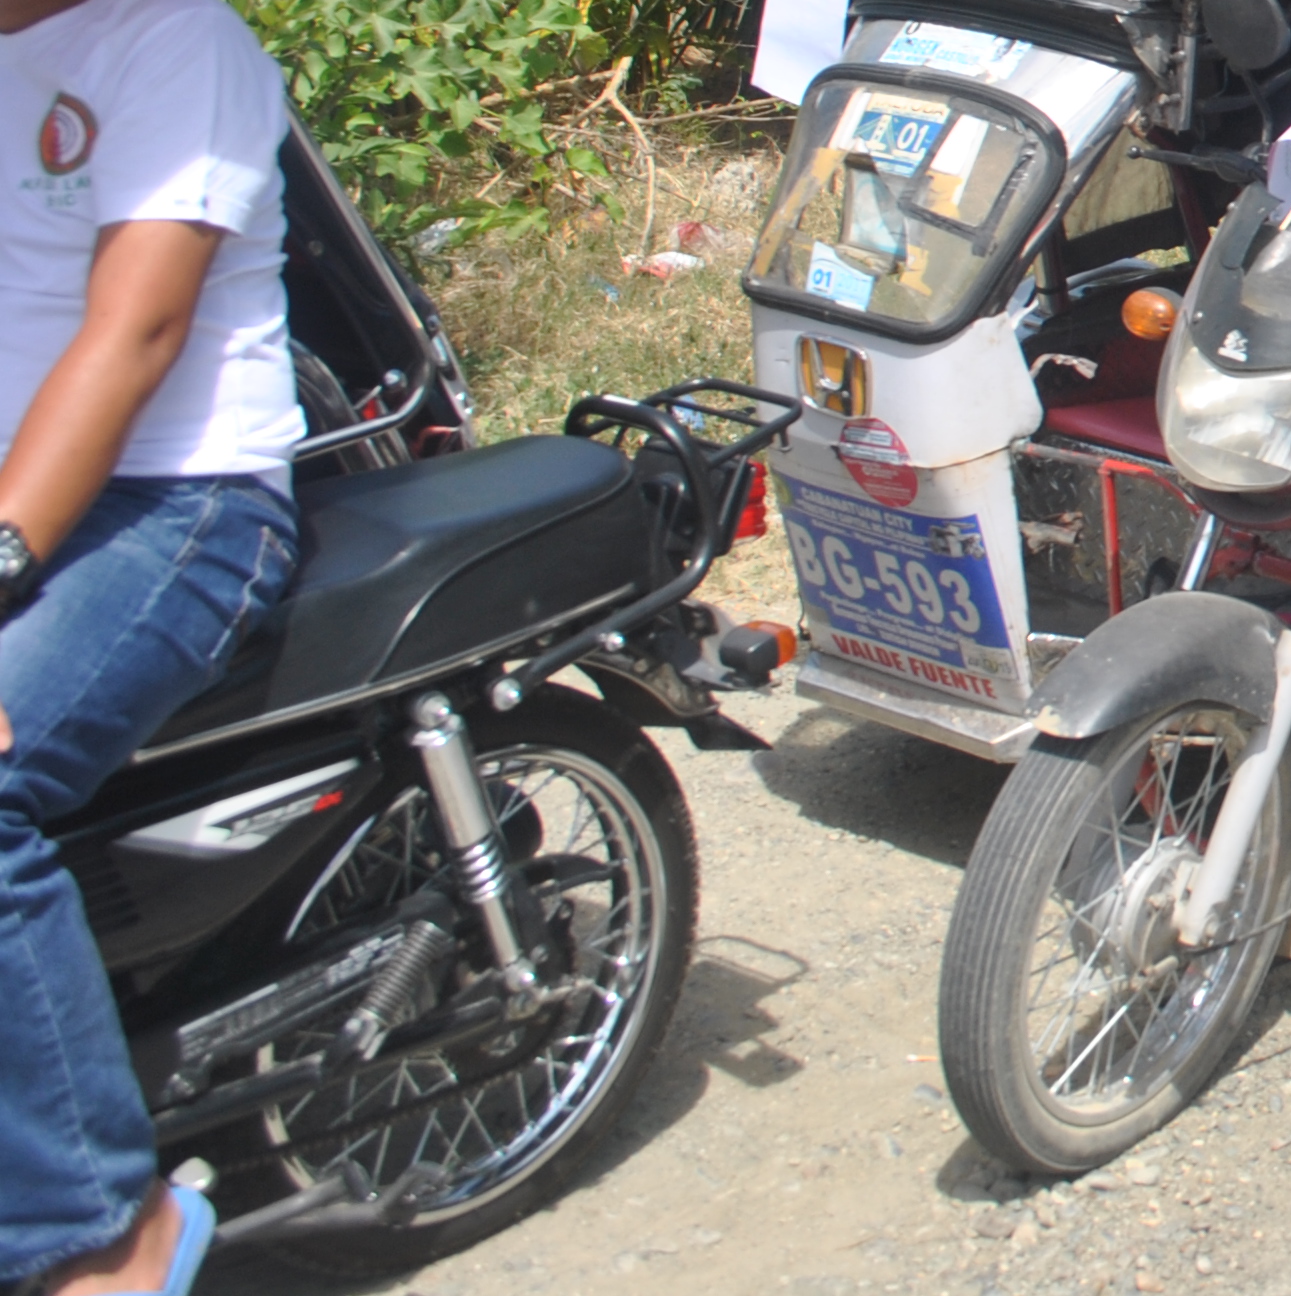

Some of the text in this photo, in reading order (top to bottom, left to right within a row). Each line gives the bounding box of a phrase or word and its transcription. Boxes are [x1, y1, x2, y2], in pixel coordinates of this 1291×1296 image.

[897, 121, 930, 153] 01
[811, 267, 832, 288] 01
[884, 512, 914, 531] CITY
[787, 519, 981, 634] BG-593
[831, 633, 905, 672] VALDE
[907, 657, 997, 700] FUENTE
